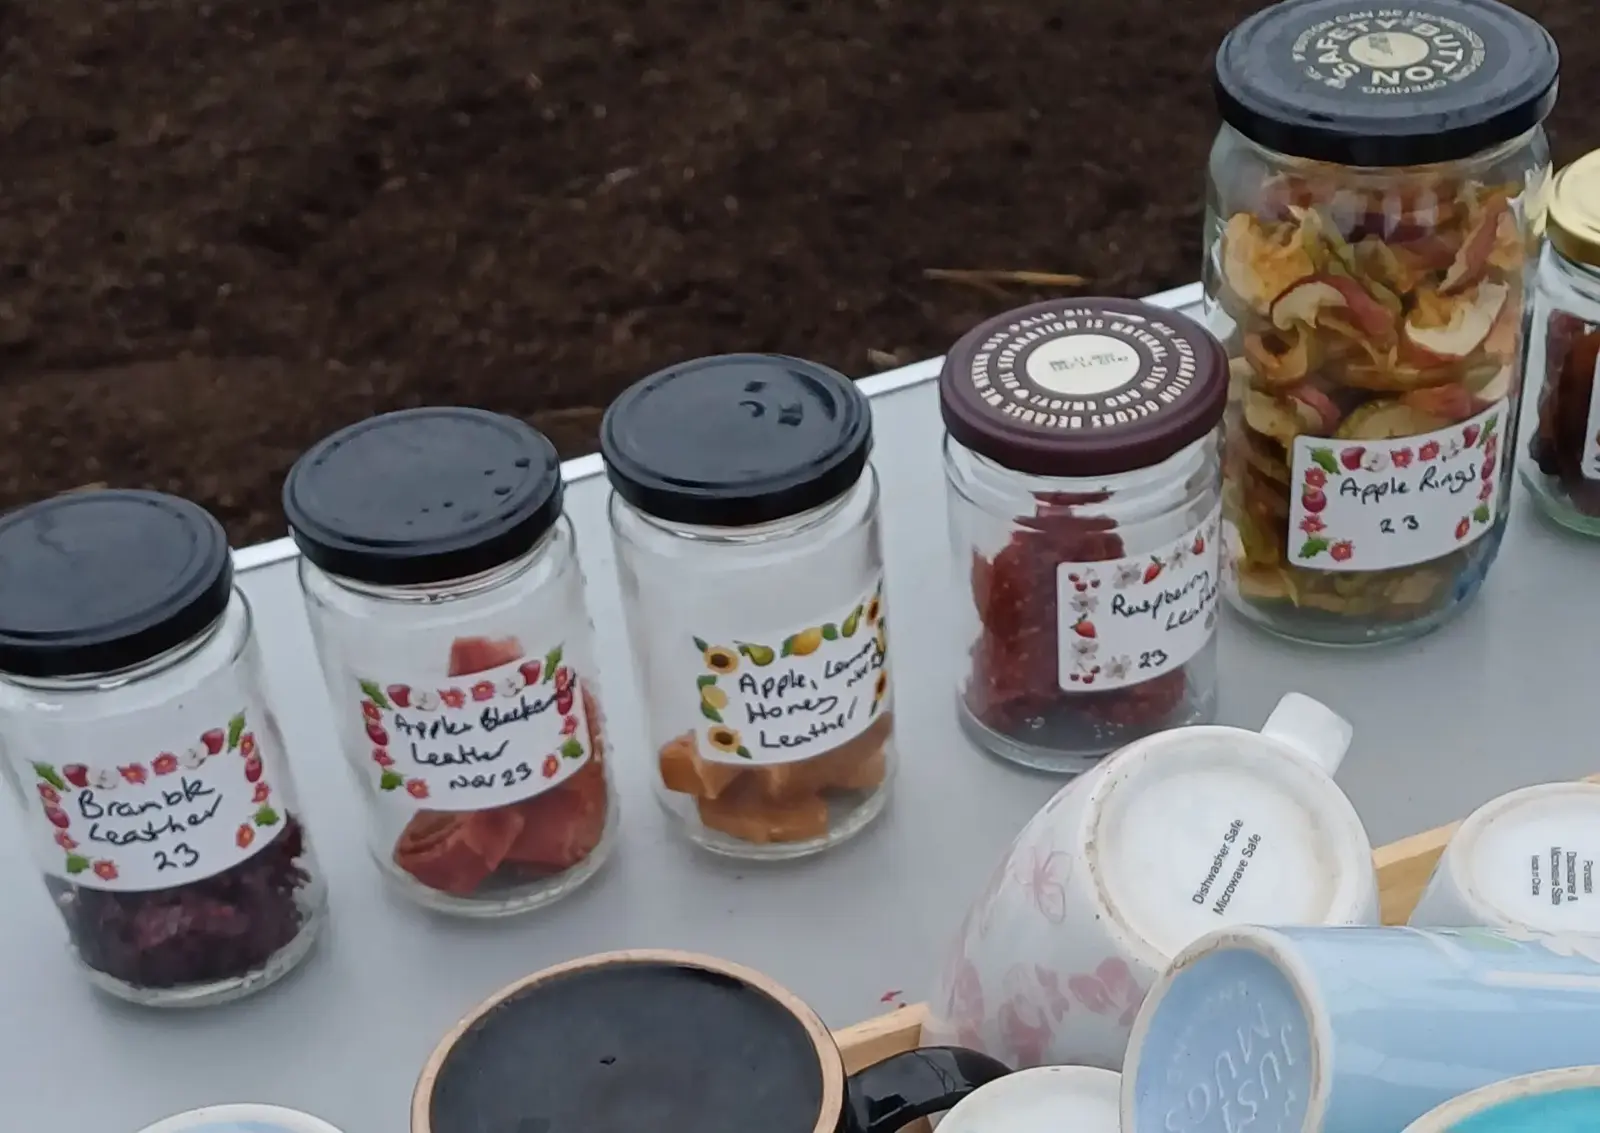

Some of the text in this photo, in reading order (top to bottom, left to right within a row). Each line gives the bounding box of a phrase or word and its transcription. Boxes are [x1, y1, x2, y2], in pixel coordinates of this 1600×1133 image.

[1316, 19, 1400, 81] SAFETY
[1372, 22, 1464, 86] BUTTON
[1158, 337, 1196, 404] SEPARATION
[1002, 401, 1082, 429] BECAUSE
[1340, 454, 1476, 504] Apple Rings
[1138, 648, 1168, 669] 23
[745, 696, 838, 725] Honey
[501, 761, 533, 787] 23
[88, 793, 223, 846] Leather
[153, 842, 200, 872] 23
[1191, 818, 1244, 906] Dishwasher Safe
[1212, 832, 1262, 916] Microwave Safe
